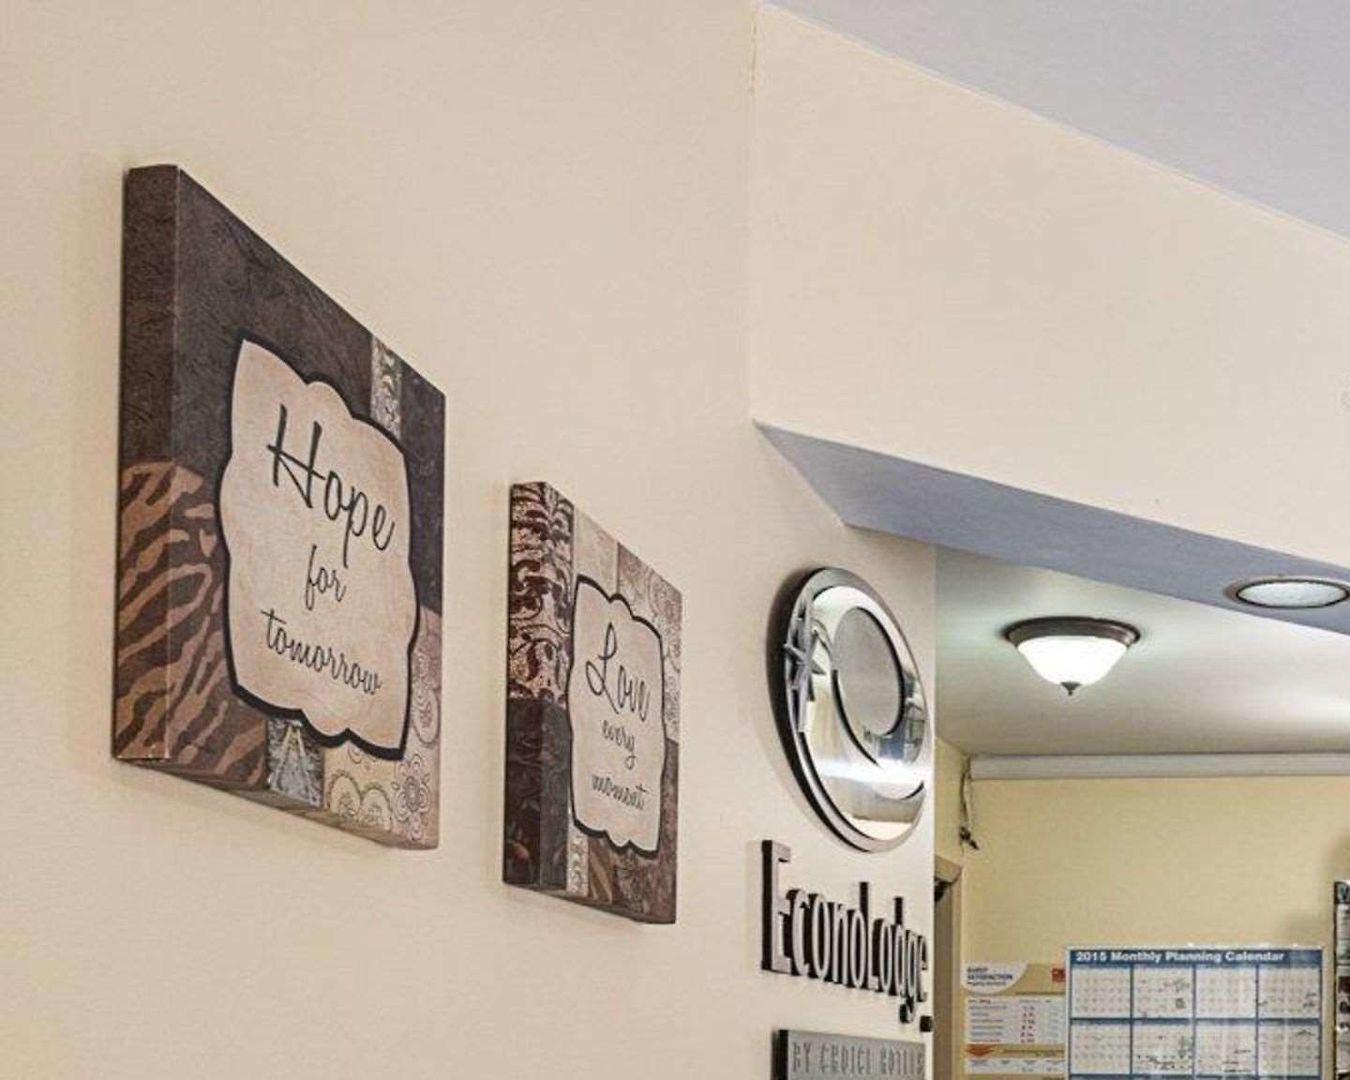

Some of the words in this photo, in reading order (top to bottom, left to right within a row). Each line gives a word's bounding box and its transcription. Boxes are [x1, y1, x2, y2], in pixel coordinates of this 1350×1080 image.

[266, 403, 395, 569] Hope
[305, 544, 346, 611] for
[260, 608, 382, 696] tomorrow
[585, 622, 650, 723] Love
[601, 719, 635, 770] every
[591, 773, 648, 811] moment
[1111, 951, 1162, 964] Monthly
[1165, 951, 1222, 964] Planning
[1225, 951, 1285, 962] Calendar
[793, 1041, 812, 1073] BY
